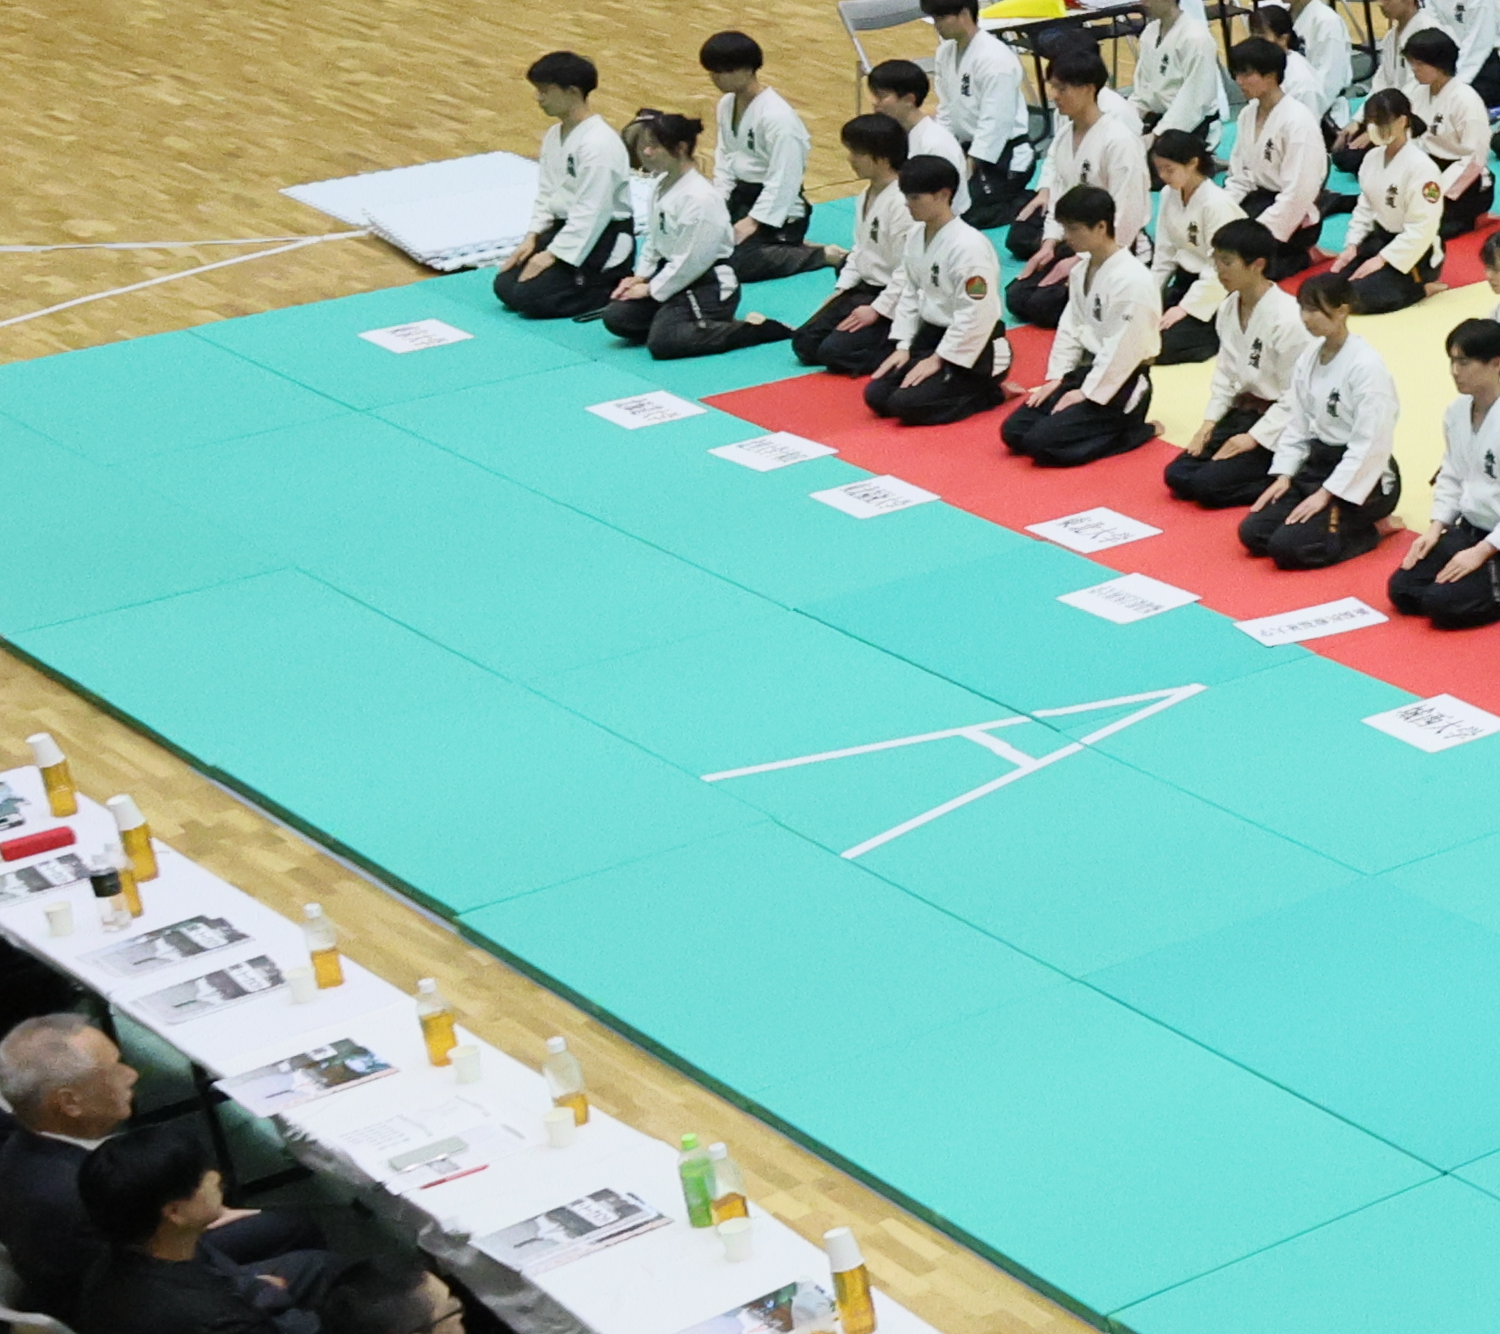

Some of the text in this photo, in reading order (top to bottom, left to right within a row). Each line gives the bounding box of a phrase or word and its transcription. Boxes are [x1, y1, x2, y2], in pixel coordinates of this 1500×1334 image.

[700, 683, 1207, 860] A
[1397, 703, 1485, 741] 城西大学
